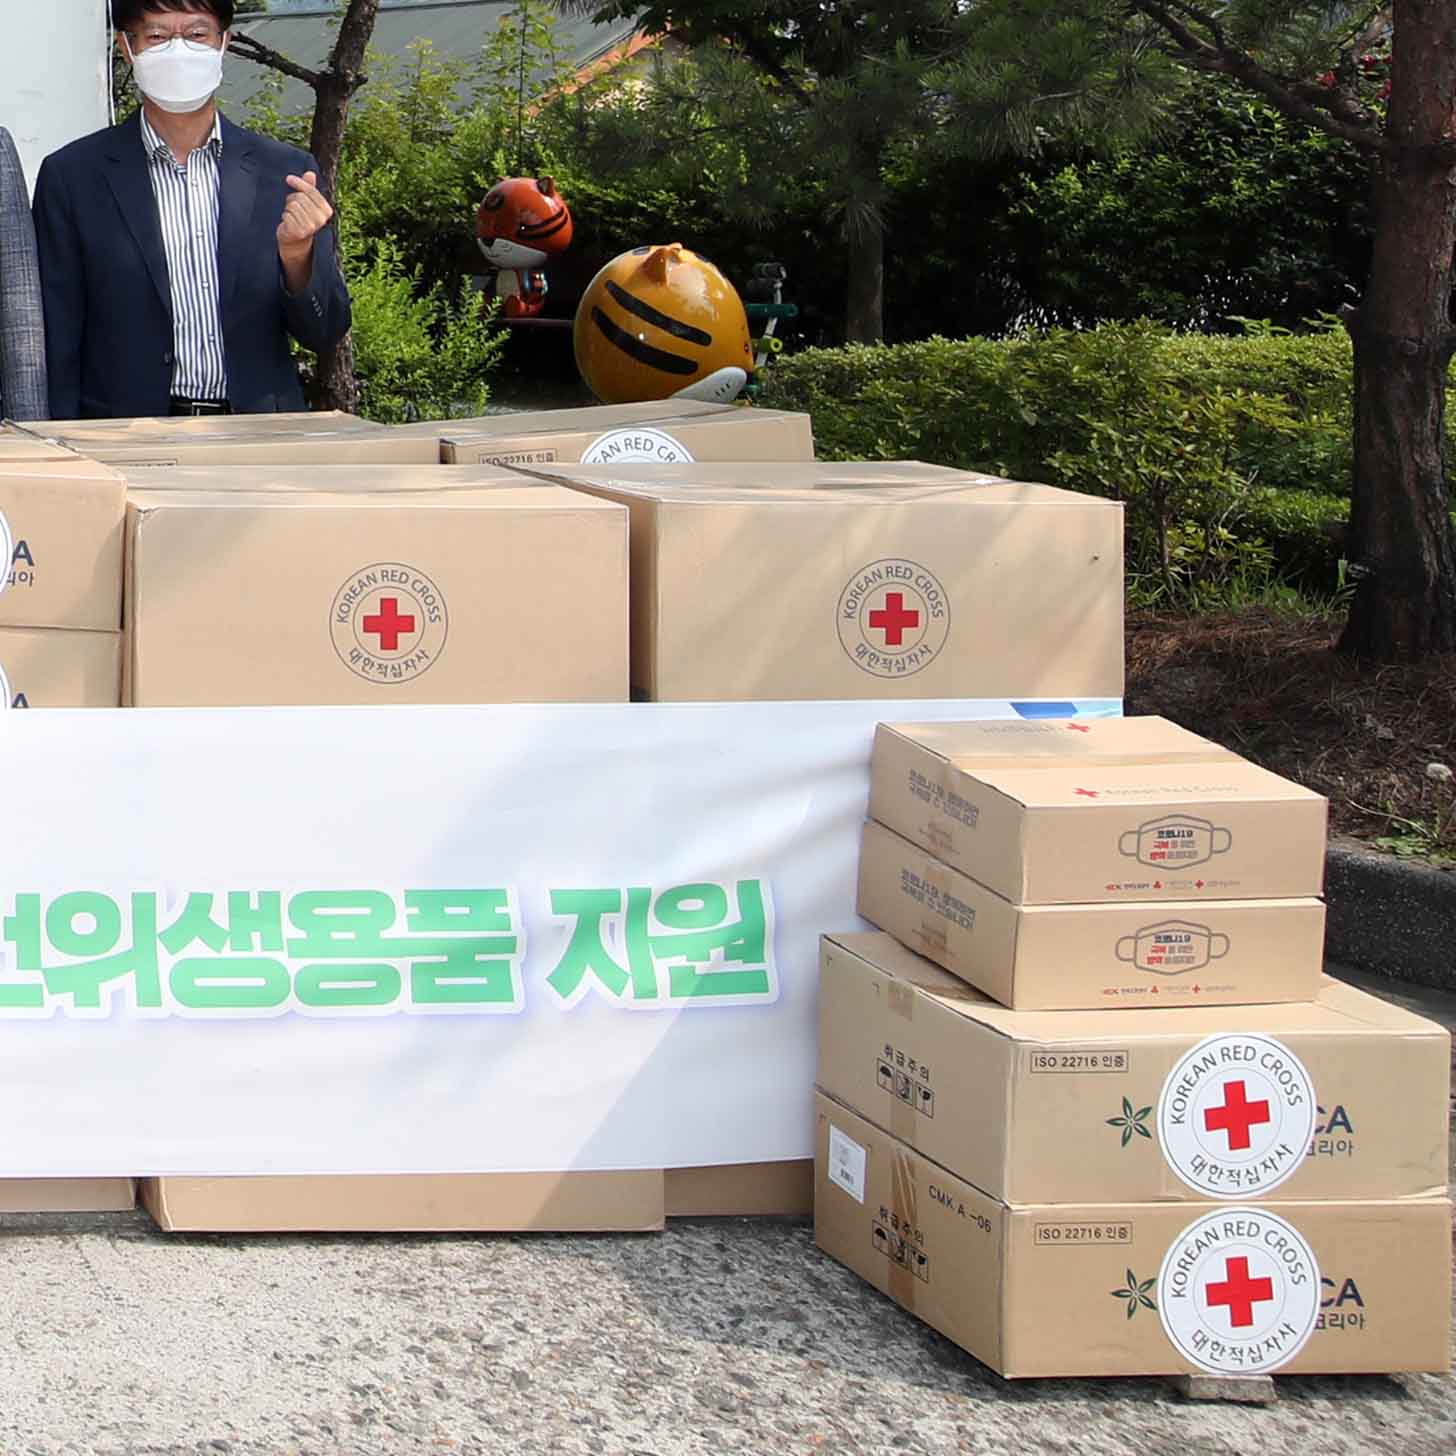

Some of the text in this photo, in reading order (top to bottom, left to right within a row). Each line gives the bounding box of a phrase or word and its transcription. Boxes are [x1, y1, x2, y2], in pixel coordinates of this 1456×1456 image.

[624, 437, 655, 451] RED
[336, 569, 442, 624] KOREAN RED CROSS
[844, 566, 944, 620] KOREAN RED CROSS
[350, 647, 430, 679] 대한적십자사
[855, 643, 933, 673] 대한적십자사
[547, 879, 774, 1002] 지원
[1033, 1053, 1126, 1070] ISO 22716 인증
[1169, 1045, 1304, 1126] KOREAN RED CROSS
[1189, 1143, 1295, 1187] 대한적십자사
[928, 1185, 953, 1210] CMK
[957, 1203, 965, 1219] A
[1038, 1224, 1130, 1243] ISO 22716 인증
[1169, 1220, 1307, 1300] KOREAN RED CROSS
[1192, 1323, 1297, 1367] 대한적십자사
